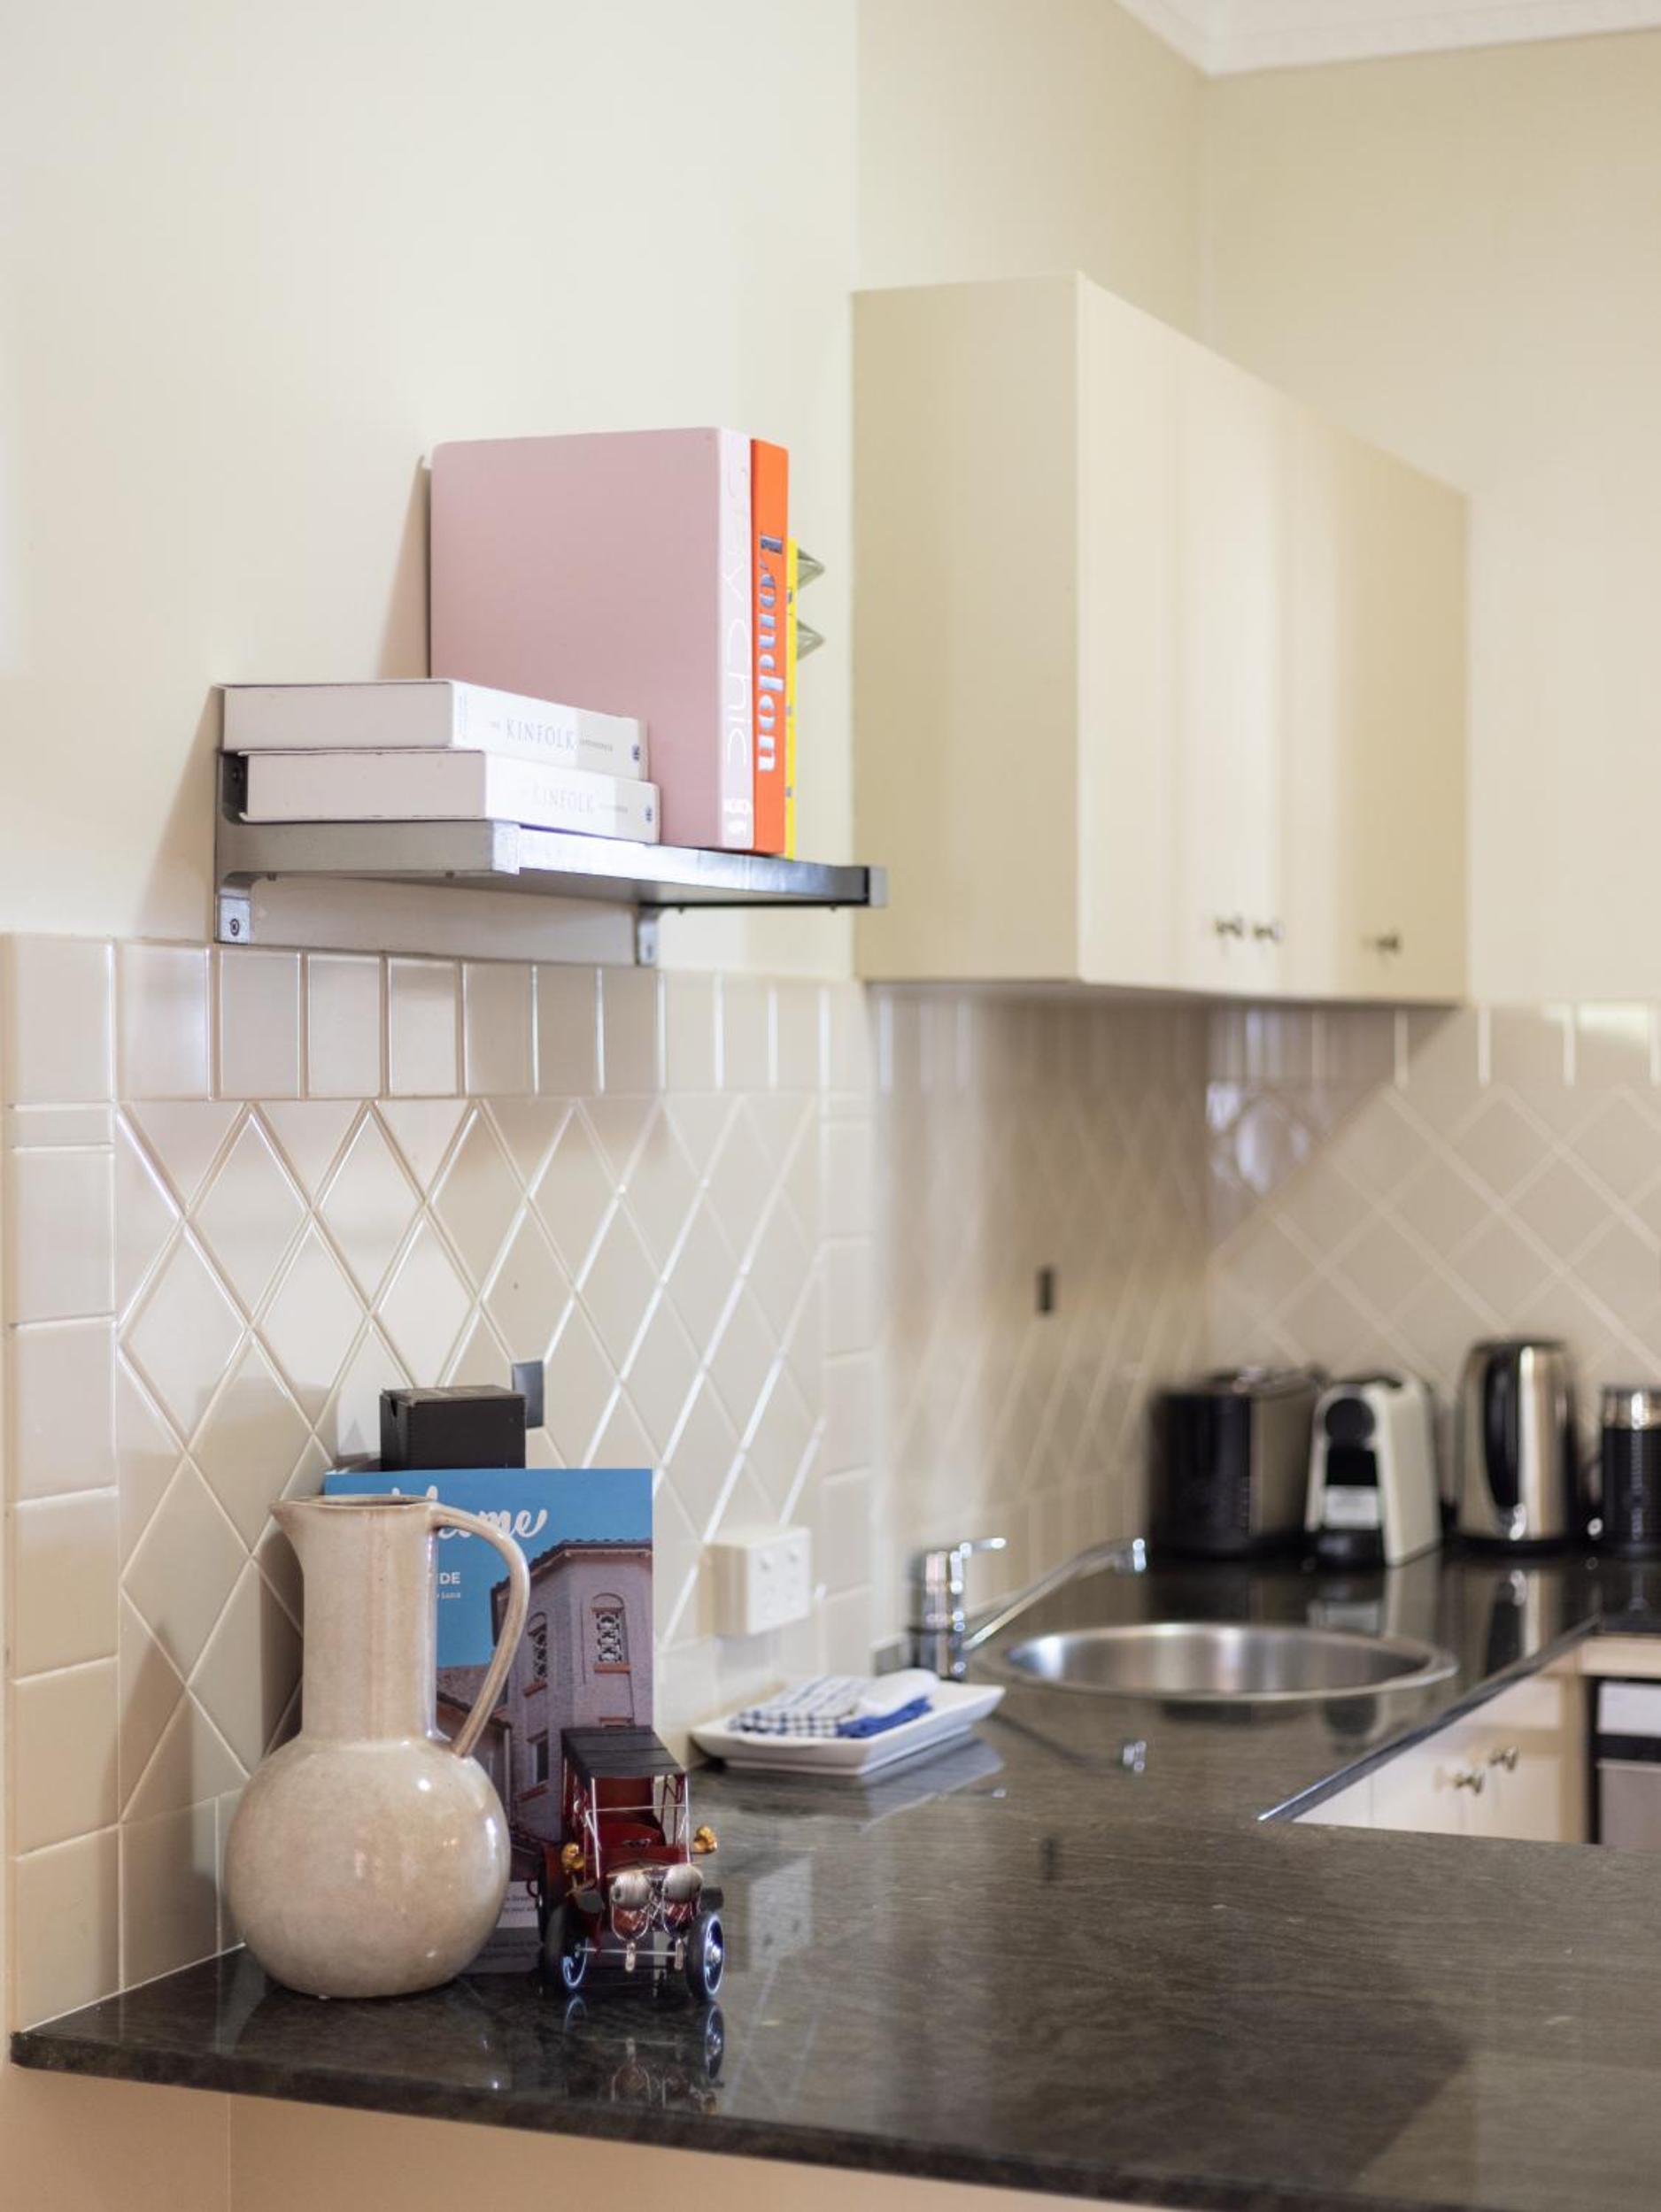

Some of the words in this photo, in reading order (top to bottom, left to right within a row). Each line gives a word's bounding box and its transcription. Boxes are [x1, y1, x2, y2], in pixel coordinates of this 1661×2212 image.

[726, 619, 751, 767] Chic
[758, 532, 784, 772] London
[506, 718, 576, 751] KINFOLK
